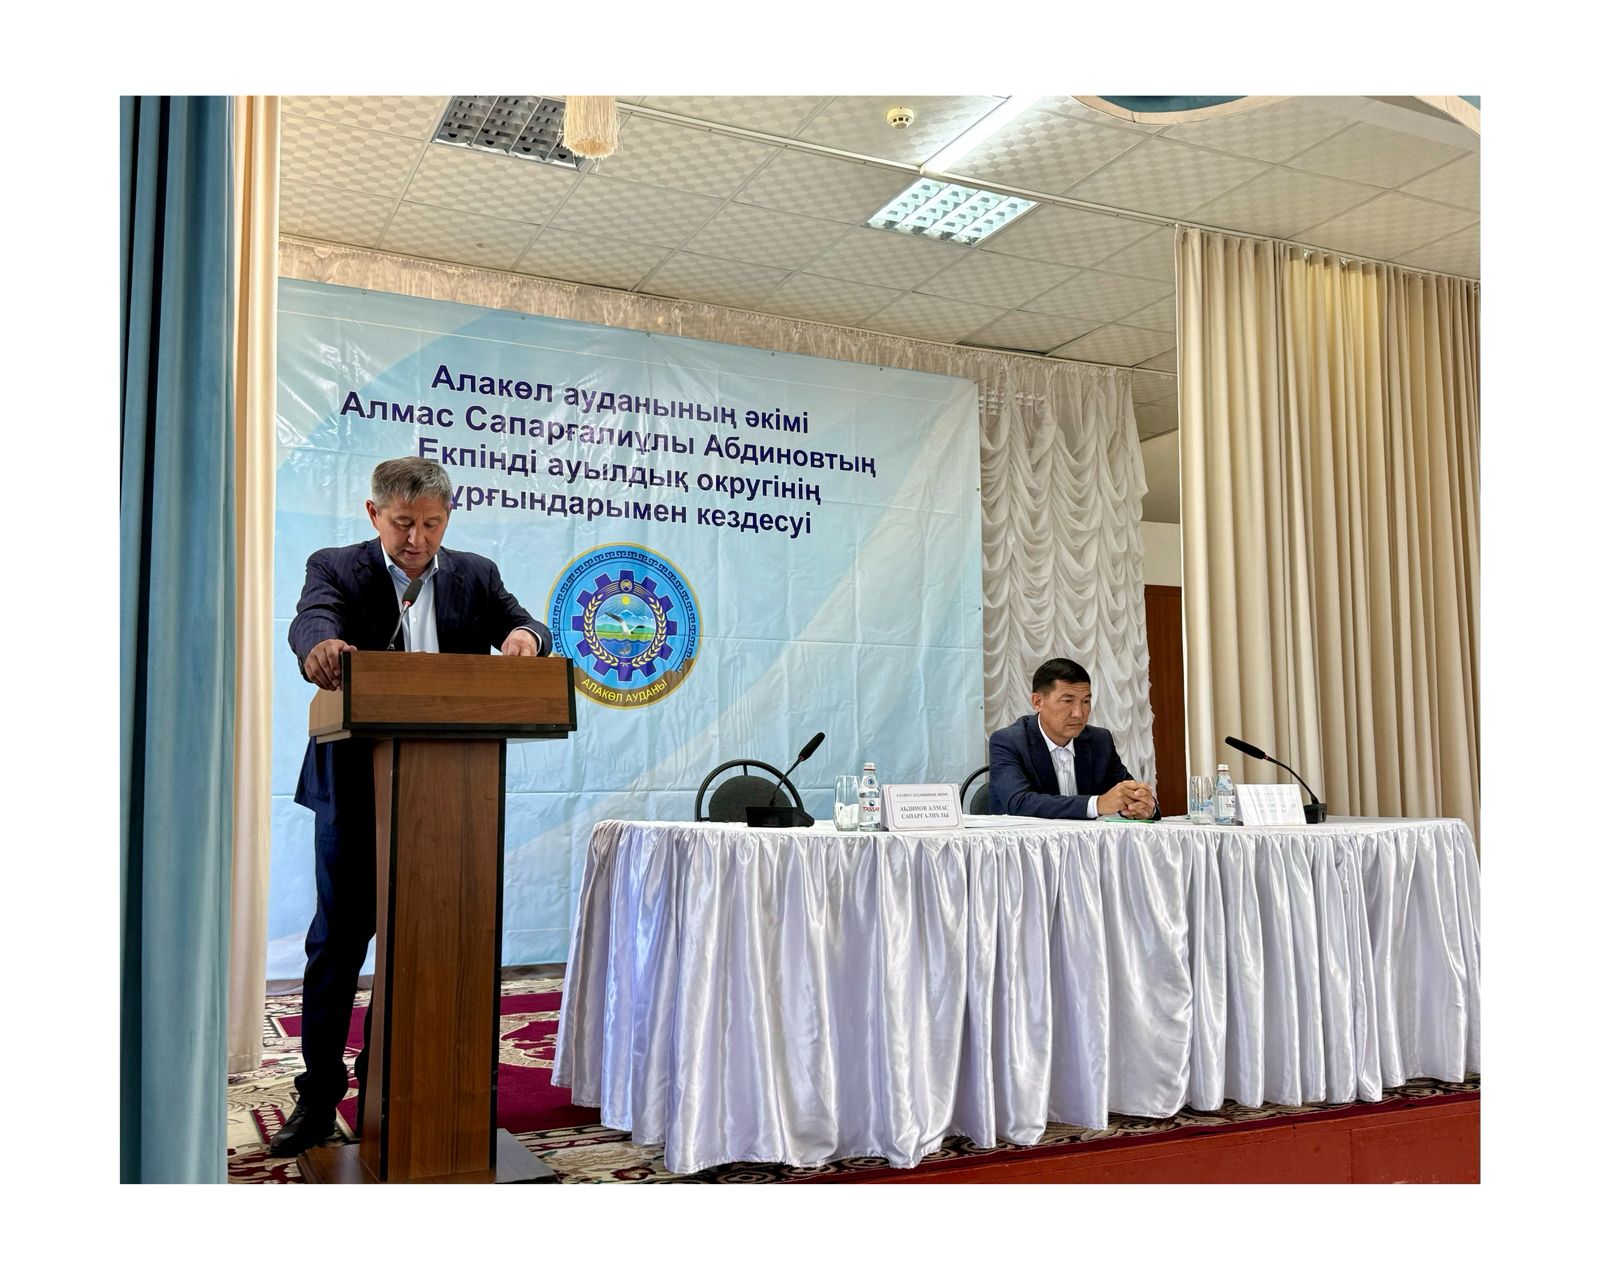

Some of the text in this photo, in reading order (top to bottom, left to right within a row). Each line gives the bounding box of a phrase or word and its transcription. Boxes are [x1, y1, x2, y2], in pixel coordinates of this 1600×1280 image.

[431, 365, 809, 434] Алакөл ауданының әкімі
[340, 391, 877, 478] Алмас Сапарғалиұлы Абдиновтың
[418, 437, 822, 506] Екпінді ауылдық округінің
[450, 484, 812, 539] ұрғындарымен кездесуі
[581, 678, 668, 703] АЛАКӨЛ АУДАНЫ
